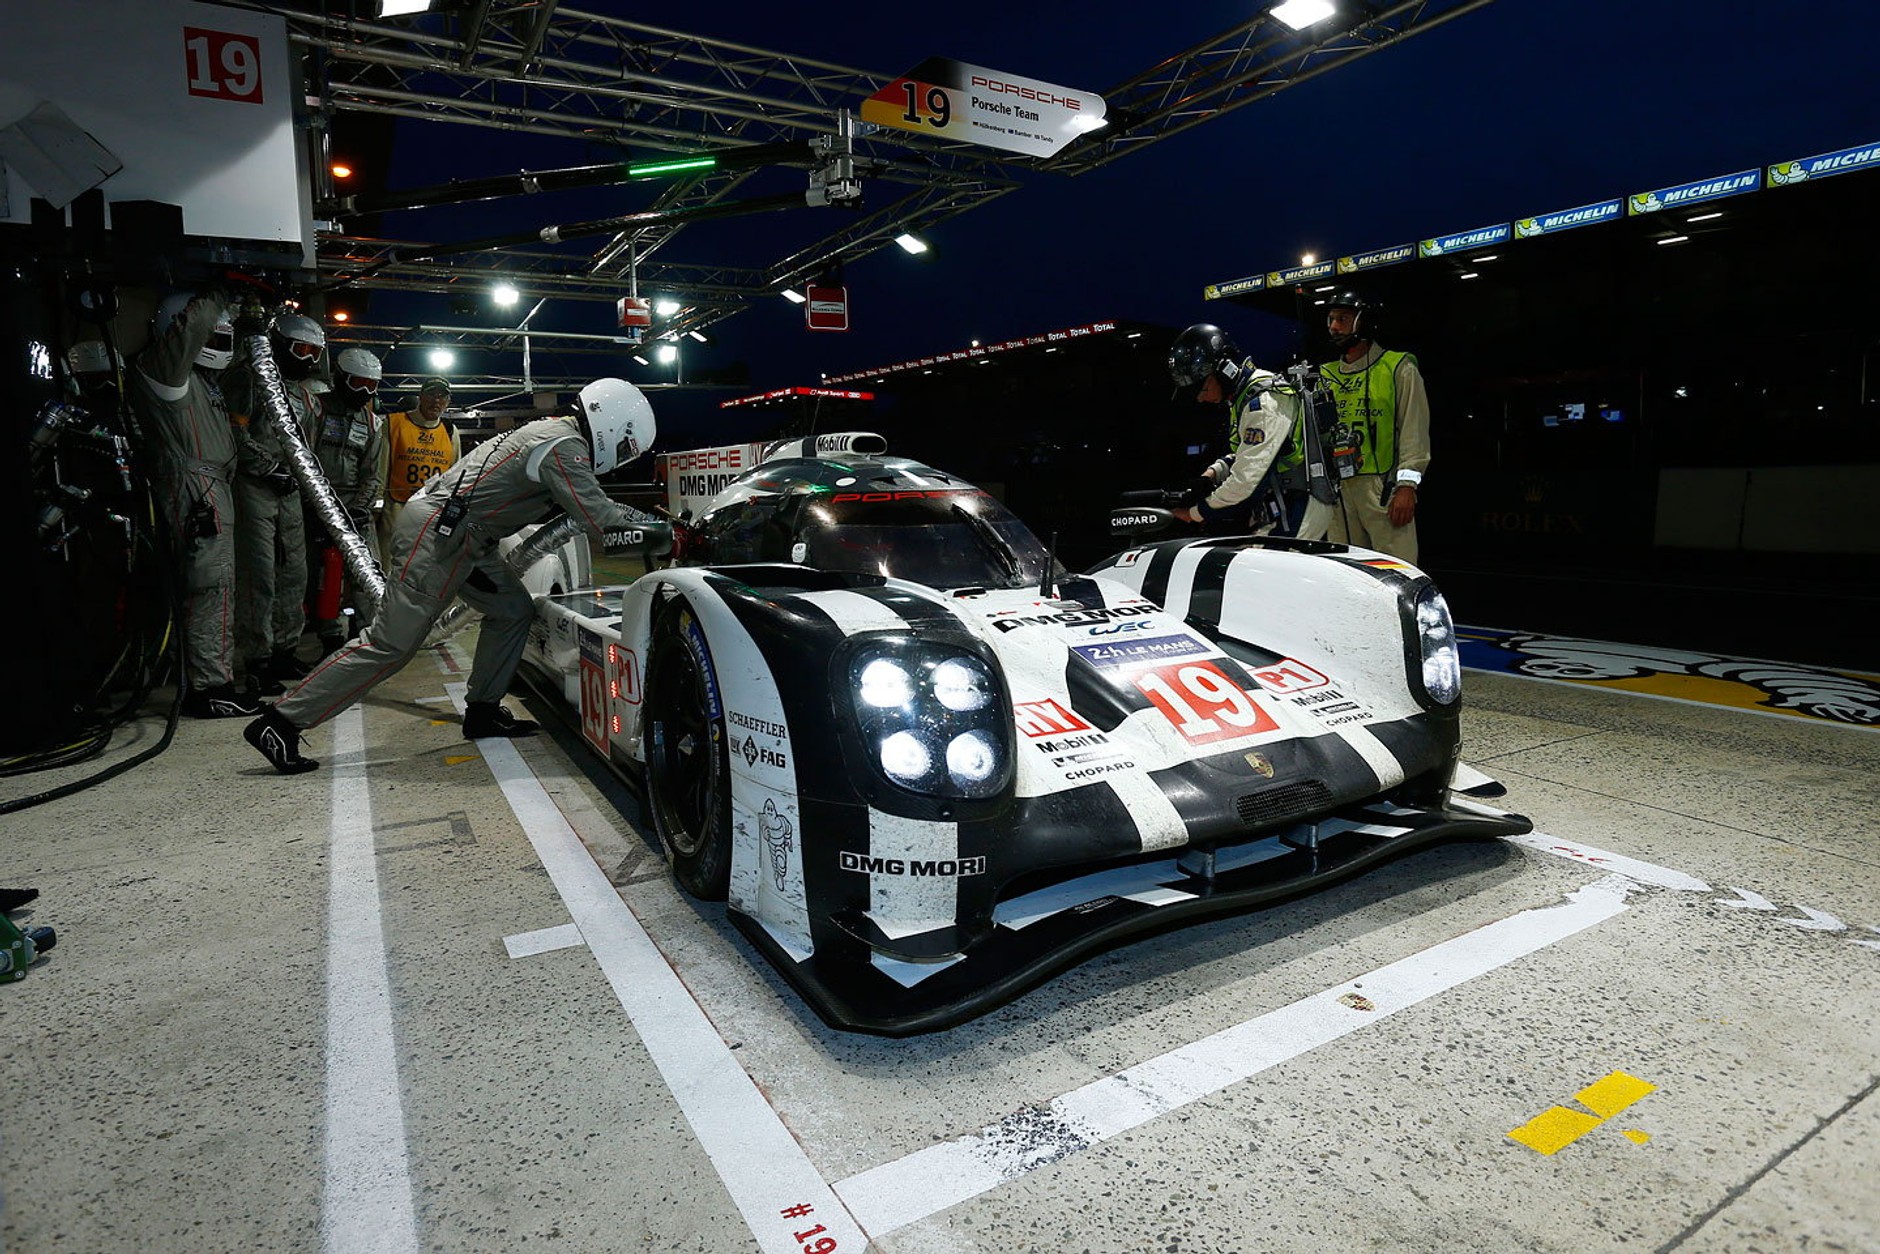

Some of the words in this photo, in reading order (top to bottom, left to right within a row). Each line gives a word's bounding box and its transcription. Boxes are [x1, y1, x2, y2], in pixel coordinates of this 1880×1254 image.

[187, 36, 259, 96] 19
[971, 76, 1081, 110] PORSCHE
[902, 82, 951, 128] 19
[972, 97, 1012, 115] Porsche
[1014, 105, 1039, 121] Team
[1664, 175, 1755, 202] MICHELIN
[1544, 204, 1619, 227] MICHELIN
[1443, 227, 1507, 248] MICHELIN
[1358, 247, 1412, 265] MICHELIN
[1285, 265, 1331, 280] MICHELIN
[1221, 278, 1262, 293] MICHELIN
[1070, 327, 1091, 337] TOTAL
[1093, 323, 1116, 332] TOTAL
[407, 447, 445, 457] MARSHAL
[670, 449, 741, 471] PORSCHE
[680, 475, 705, 496] DMG
[1111, 515, 1157, 526] CHOPARD
[1480, 512, 1584, 534] ROLEX
[992, 611, 1078, 633] DMG
[1089, 621, 1155, 635] WEC
[1126, 646, 1148, 654] LE
[1148, 640, 1195, 652] MANS
[690, 634, 716, 714] MICHELIN
[1254, 668, 1312, 688] P1
[583, 666, 604, 740] 19
[1138, 666, 1258, 736] 19
[1290, 692, 1332, 706] Mobil
[729, 711, 786, 739] SCHAEFFLER
[1013, 702, 1077, 737] HY
[1326, 712, 1373, 726] CHOPARD
[1035, 736, 1089, 753] Mobil
[760, 748, 786, 768] FAG
[1065, 761, 1135, 780] CHOPARD
[841, 853, 905, 875] DMG
[910, 856, 985, 876] MORI
[780, 1203, 814, 1219] #
[793, 1224, 837, 1254] 19
